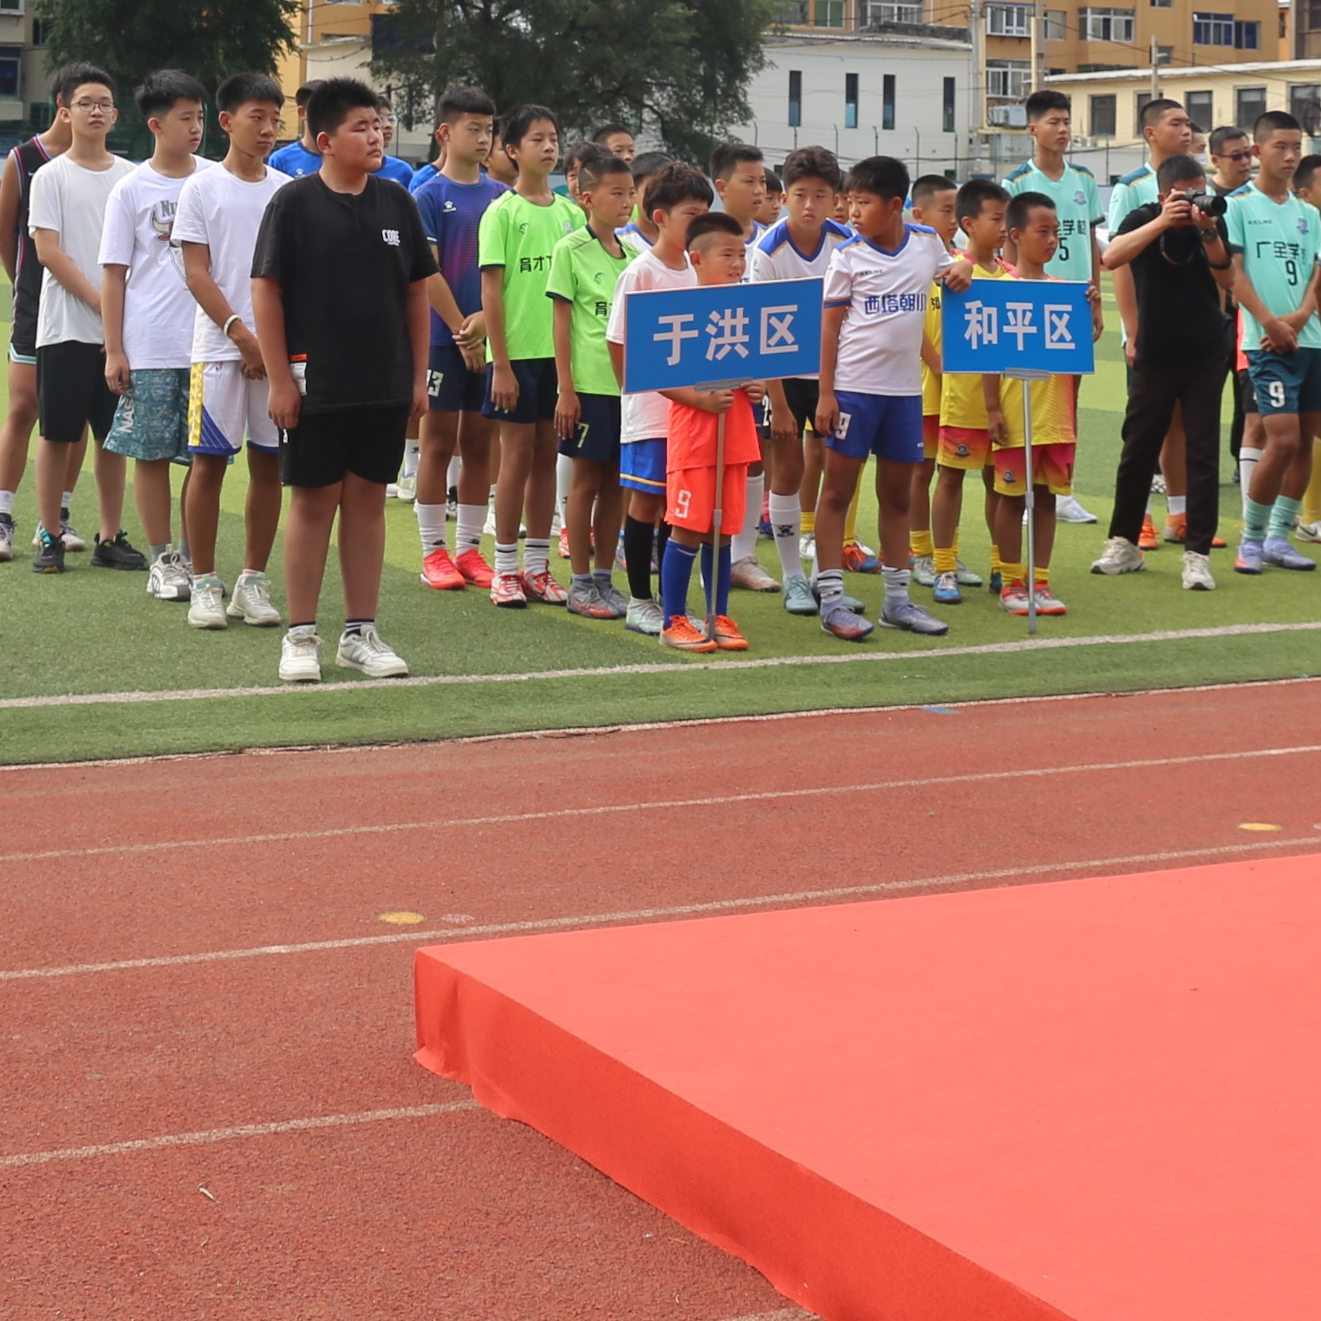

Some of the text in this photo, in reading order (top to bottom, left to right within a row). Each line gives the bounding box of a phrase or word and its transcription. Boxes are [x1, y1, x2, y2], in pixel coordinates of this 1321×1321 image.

[1058, 237, 1070, 262] 5
[1285, 259, 1298, 287] 9
[653, 304, 799, 366] 于洪区
[964, 299, 1076, 352] 和平区
[1269, 380, 1286, 408] 9
[674, 489, 692, 519] 9
